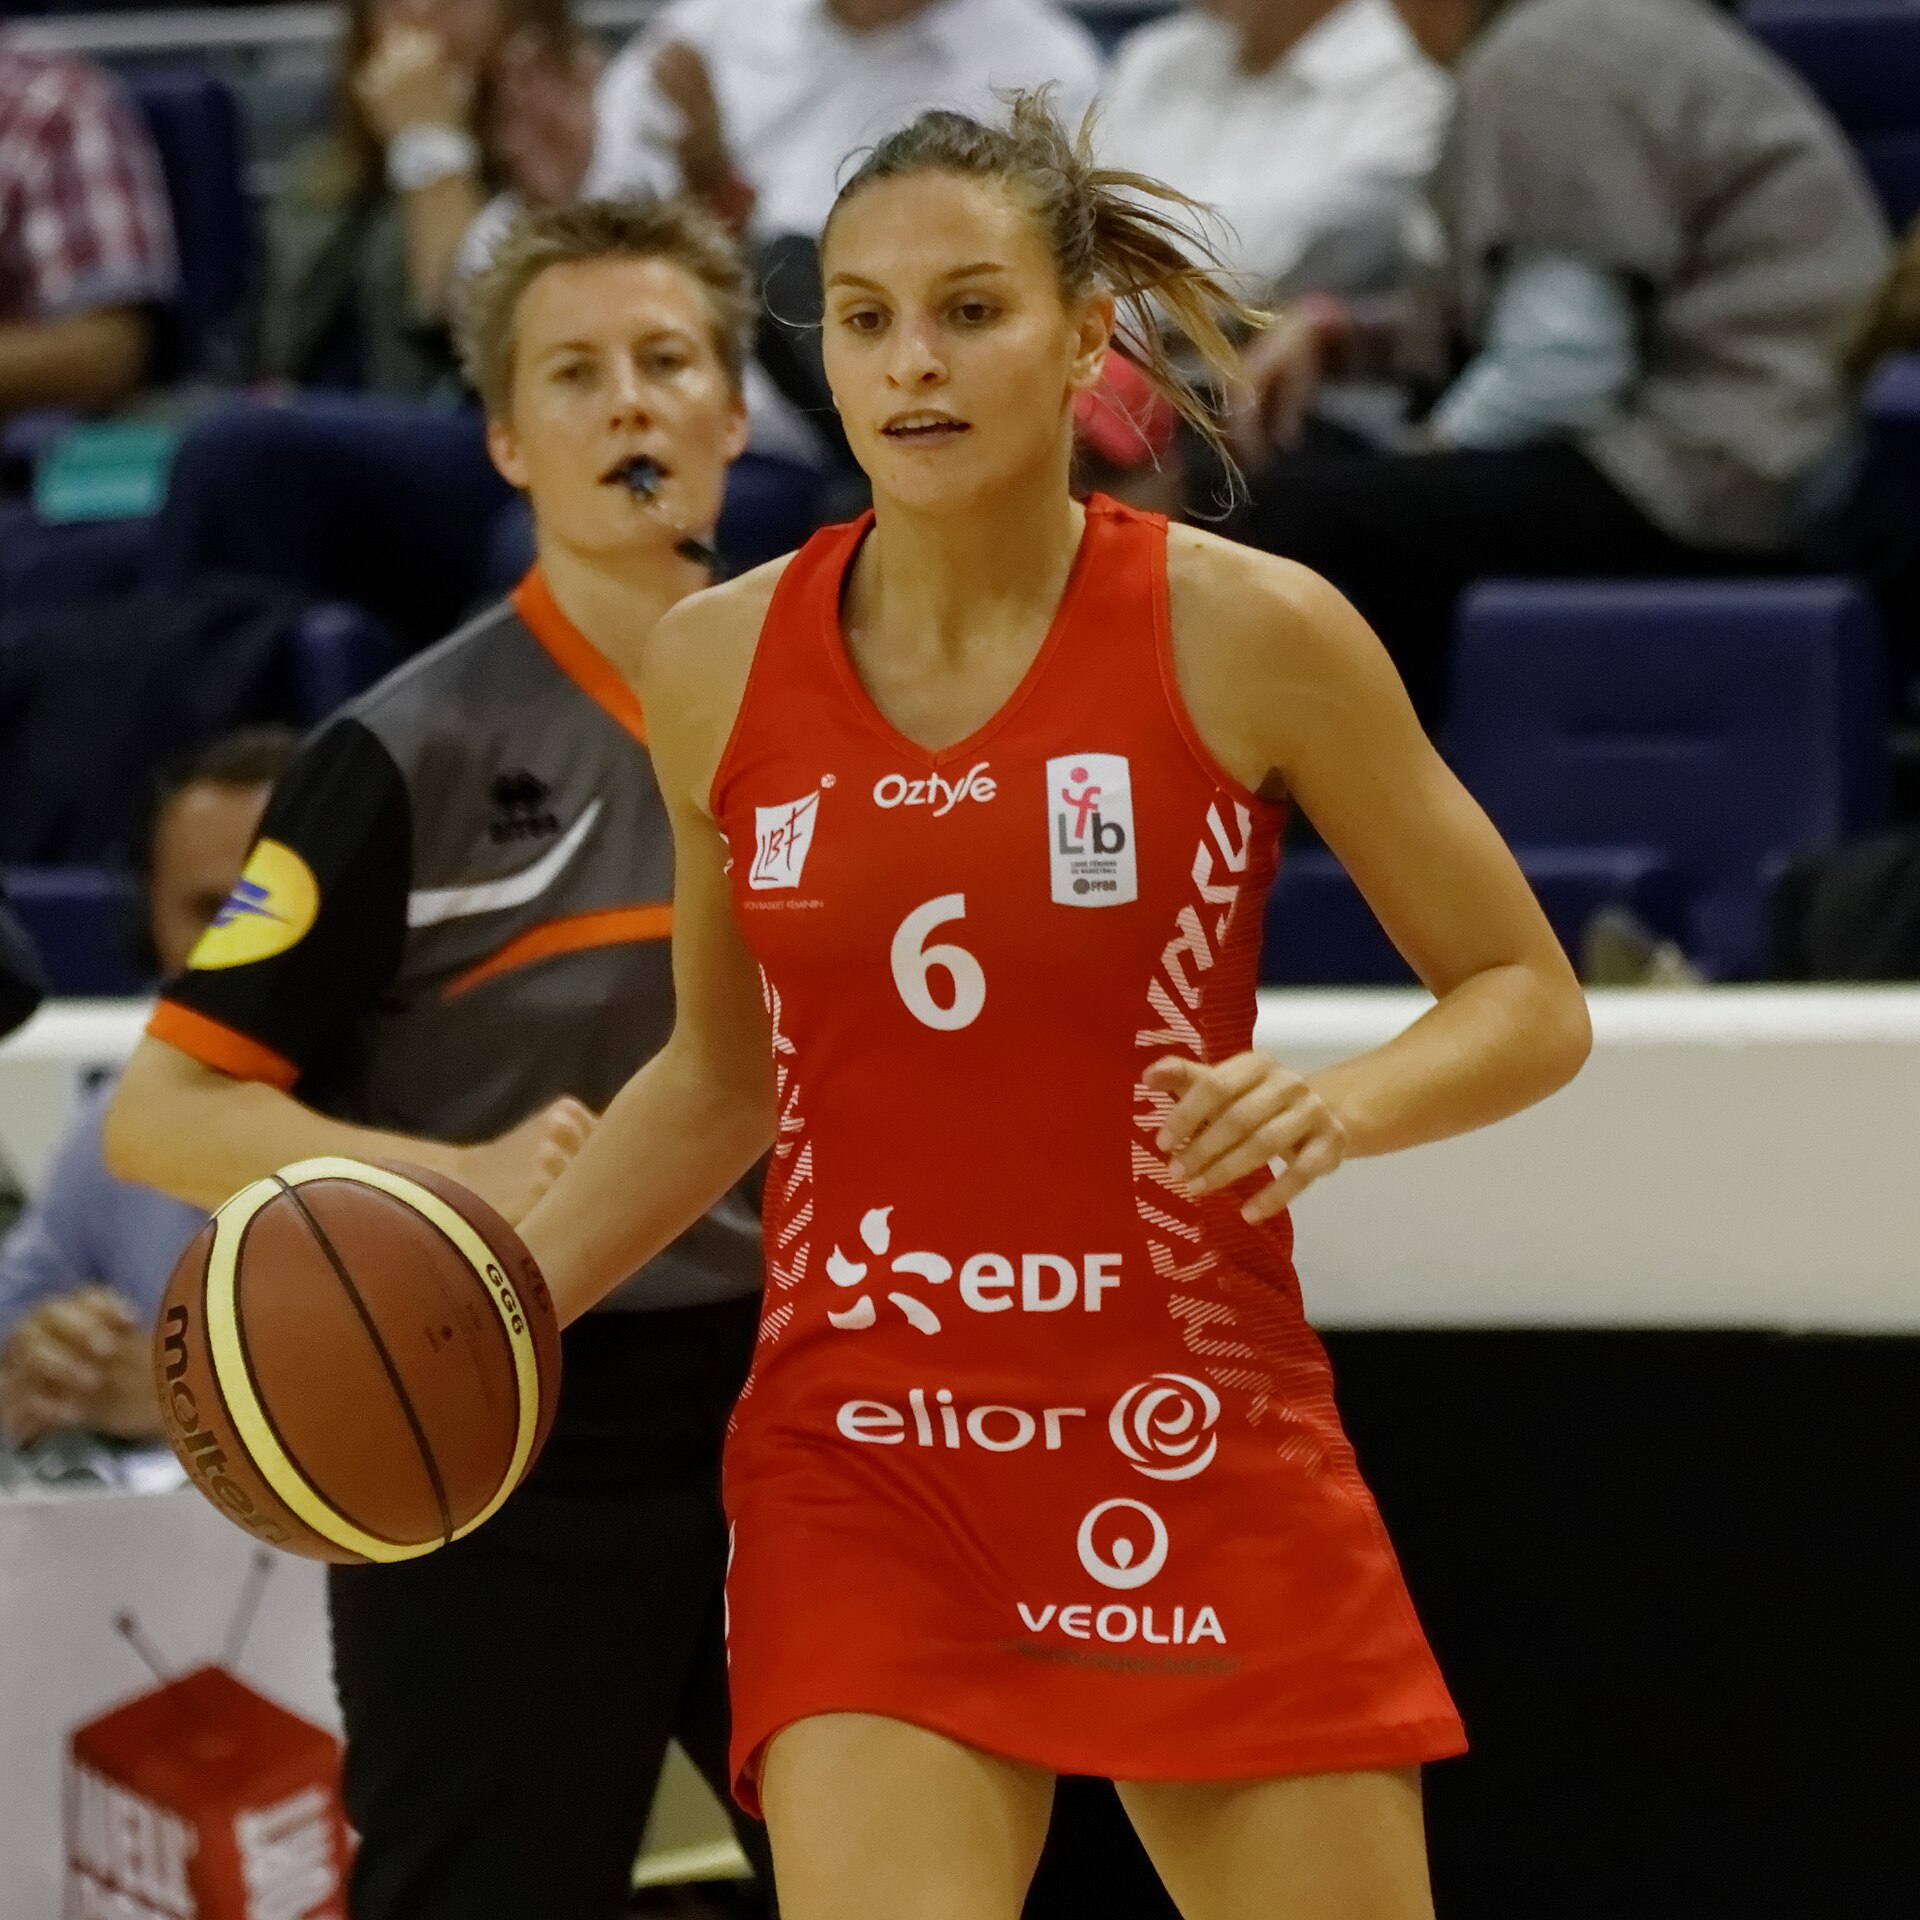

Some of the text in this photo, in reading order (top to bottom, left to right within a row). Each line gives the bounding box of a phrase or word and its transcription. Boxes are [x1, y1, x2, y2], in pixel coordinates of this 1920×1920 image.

[891, 892, 986, 1031] 6
[486, 1262, 525, 1336] GG6
[154, 1304, 293, 1545] molten
[836, 1388, 1086, 1453] elior
[1017, 1602, 1227, 1645] VEOLIA
